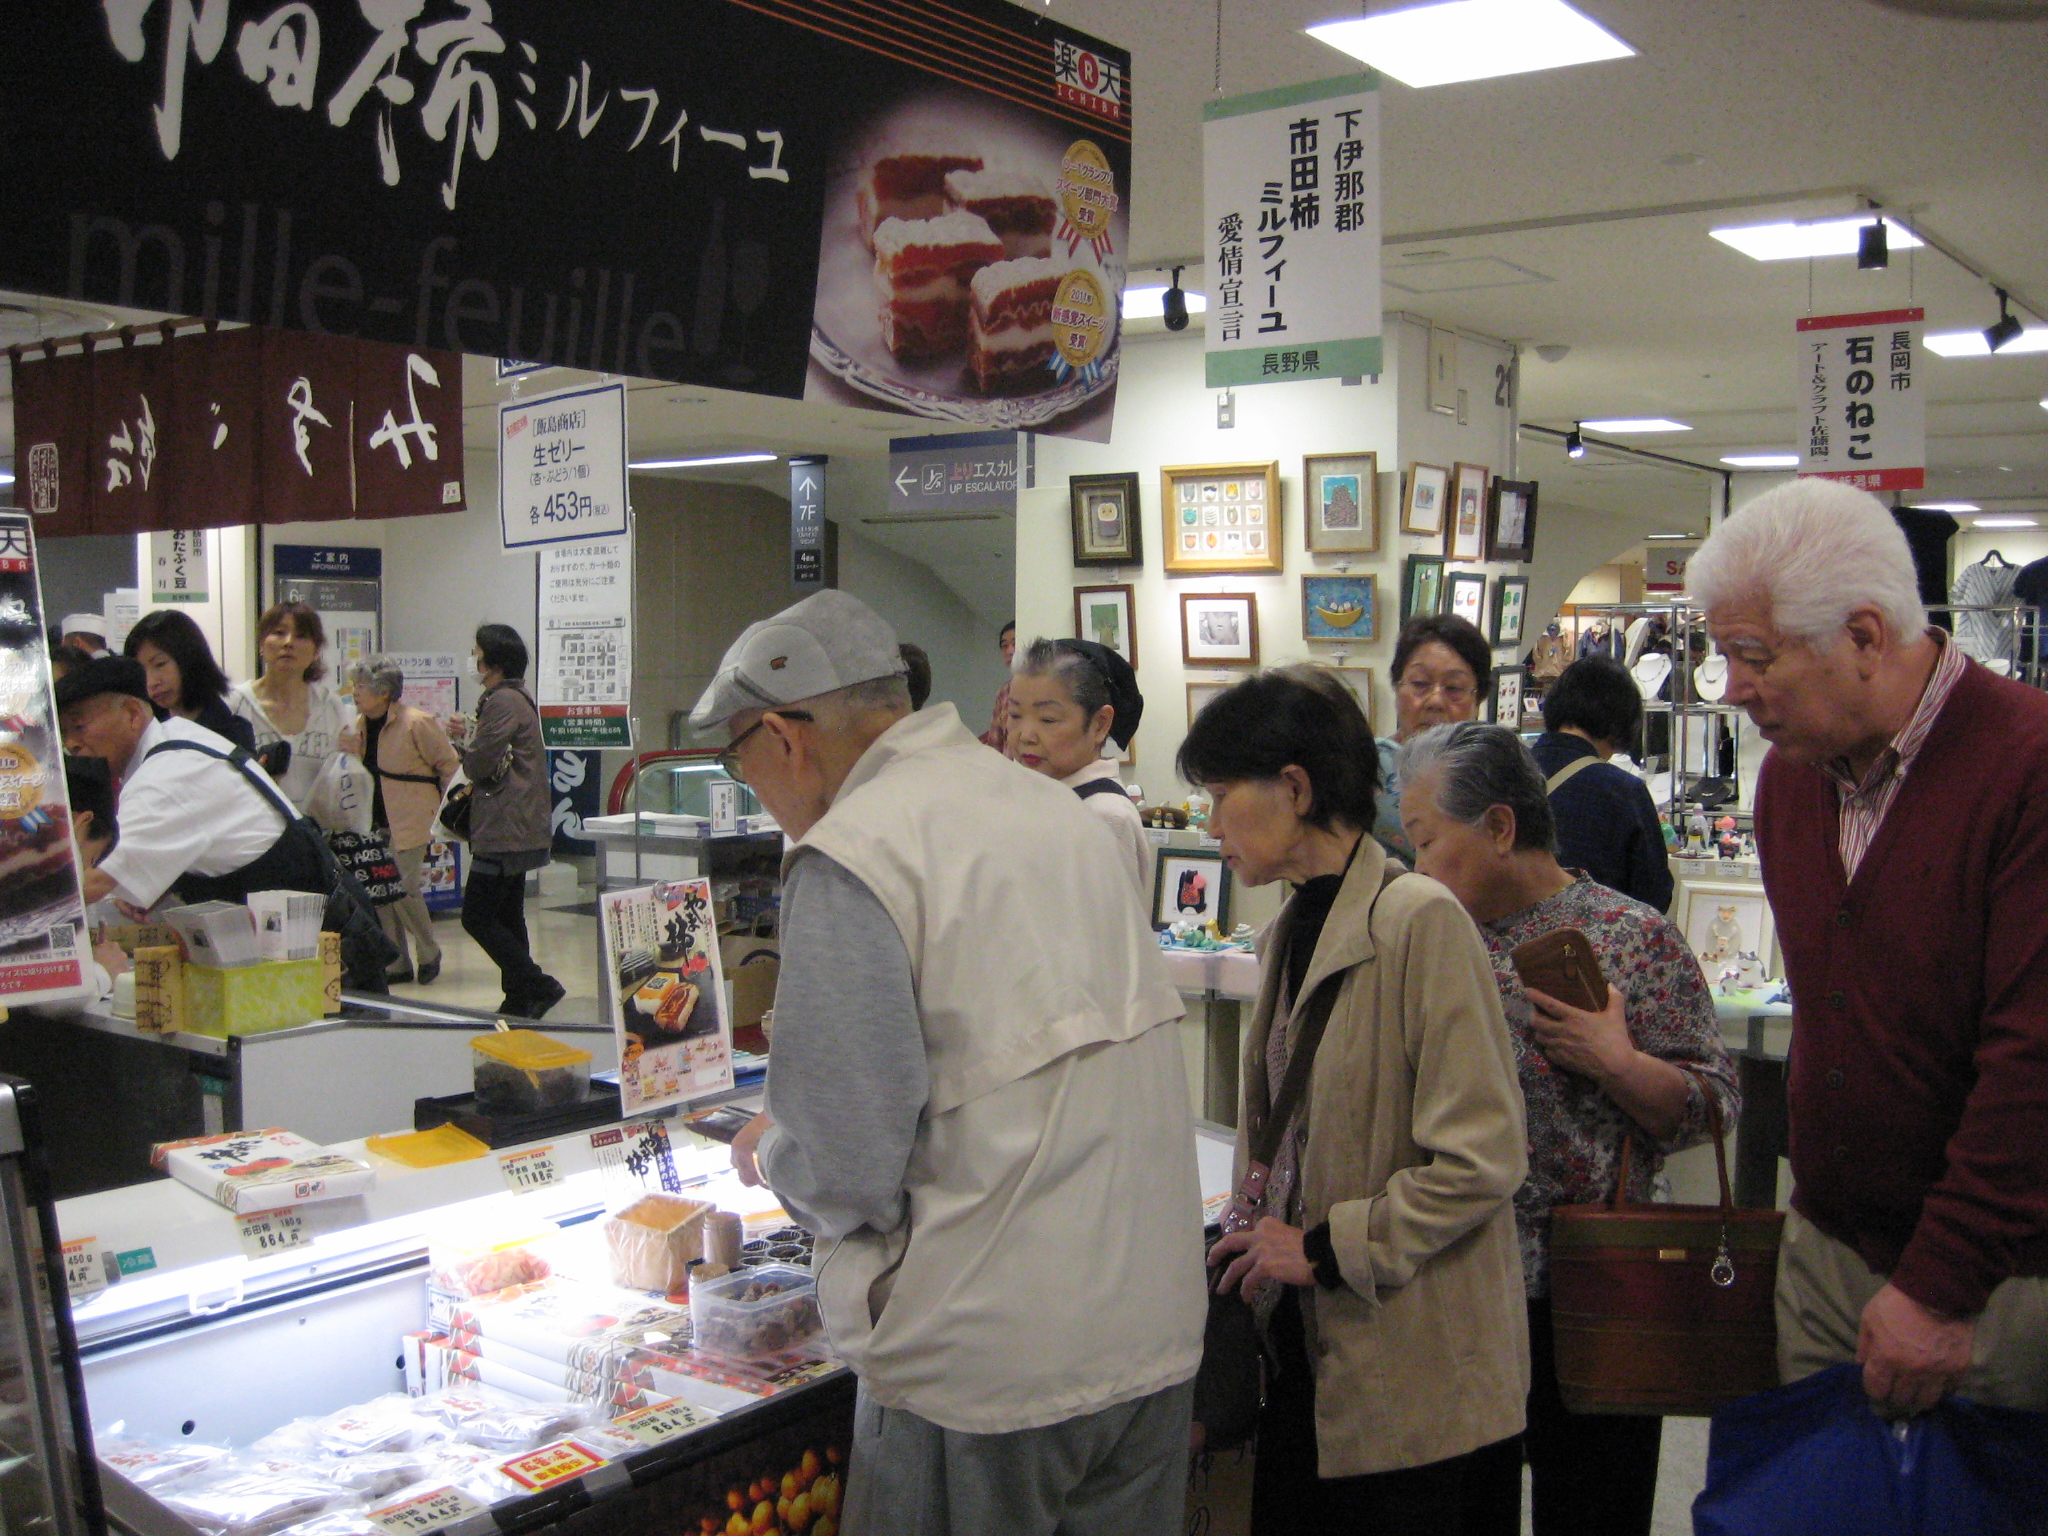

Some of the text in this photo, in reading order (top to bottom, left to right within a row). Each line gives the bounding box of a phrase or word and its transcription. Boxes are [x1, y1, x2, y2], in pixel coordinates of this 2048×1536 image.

[1058, 84, 1119, 118] ICHIBA
[1289, 118, 1320, 231] 市田柿
[1334, 109, 1364, 233] 下伊那郡
[1218, 212, 1244, 341] 愛情宣言
[1257, 182, 1287, 333] ミルフィーユ
[66, 200, 690, 380] mille-feuille
[1262, 350, 1320, 376] 長野県
[1890, 331, 1911, 391] 長岡市
[1845, 336, 1875, 460] 石のねこ
[533, 439, 585, 467] 生ゼリー
[799, 504, 816, 520] 7F
[949, 483, 962, 494] UP
[173, 529, 187, 589] おたふく豆
[311, 563, 350, 571] INFORMATION
[567, 706, 602, 716] お食事処
[519, 1449, 573, 1473] 広告の品
